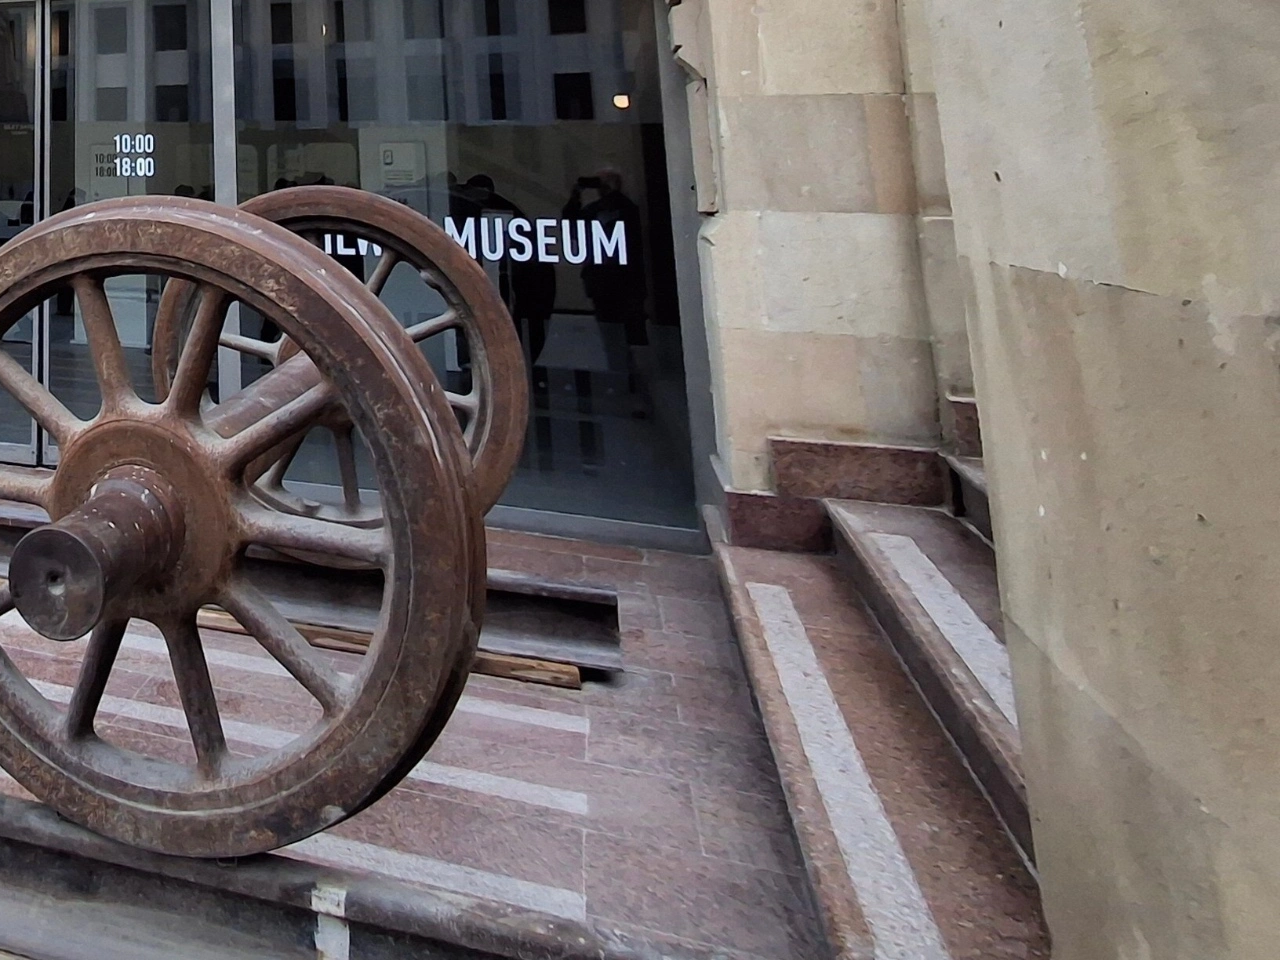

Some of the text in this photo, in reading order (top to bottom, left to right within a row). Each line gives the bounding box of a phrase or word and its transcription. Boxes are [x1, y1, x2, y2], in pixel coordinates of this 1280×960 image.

[113, 133, 154, 153] 10:00
[113, 157, 155, 177] 18:00
[444, 216, 628, 266] MUSEUM
